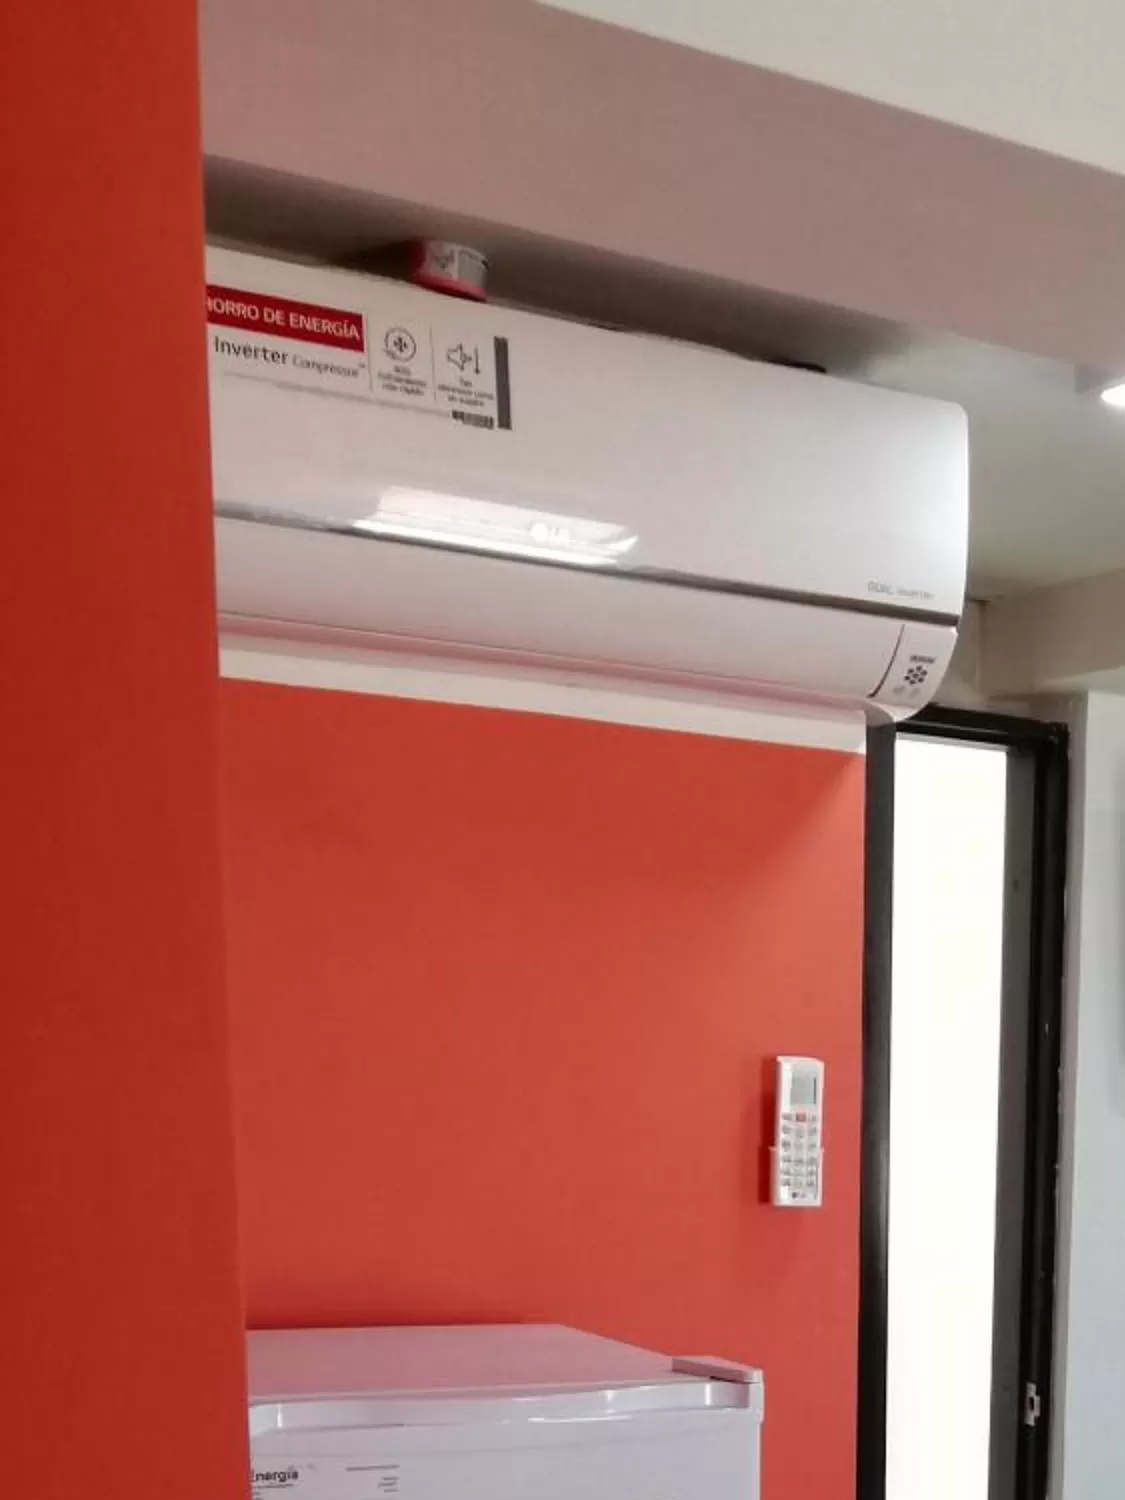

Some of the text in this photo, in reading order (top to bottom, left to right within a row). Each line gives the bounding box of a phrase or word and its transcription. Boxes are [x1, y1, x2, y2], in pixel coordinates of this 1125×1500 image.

[263, 306, 286, 325] DE
[289, 312, 361, 341] ENERGÍA
[213, 335, 359, 377] Inverter Compressor
